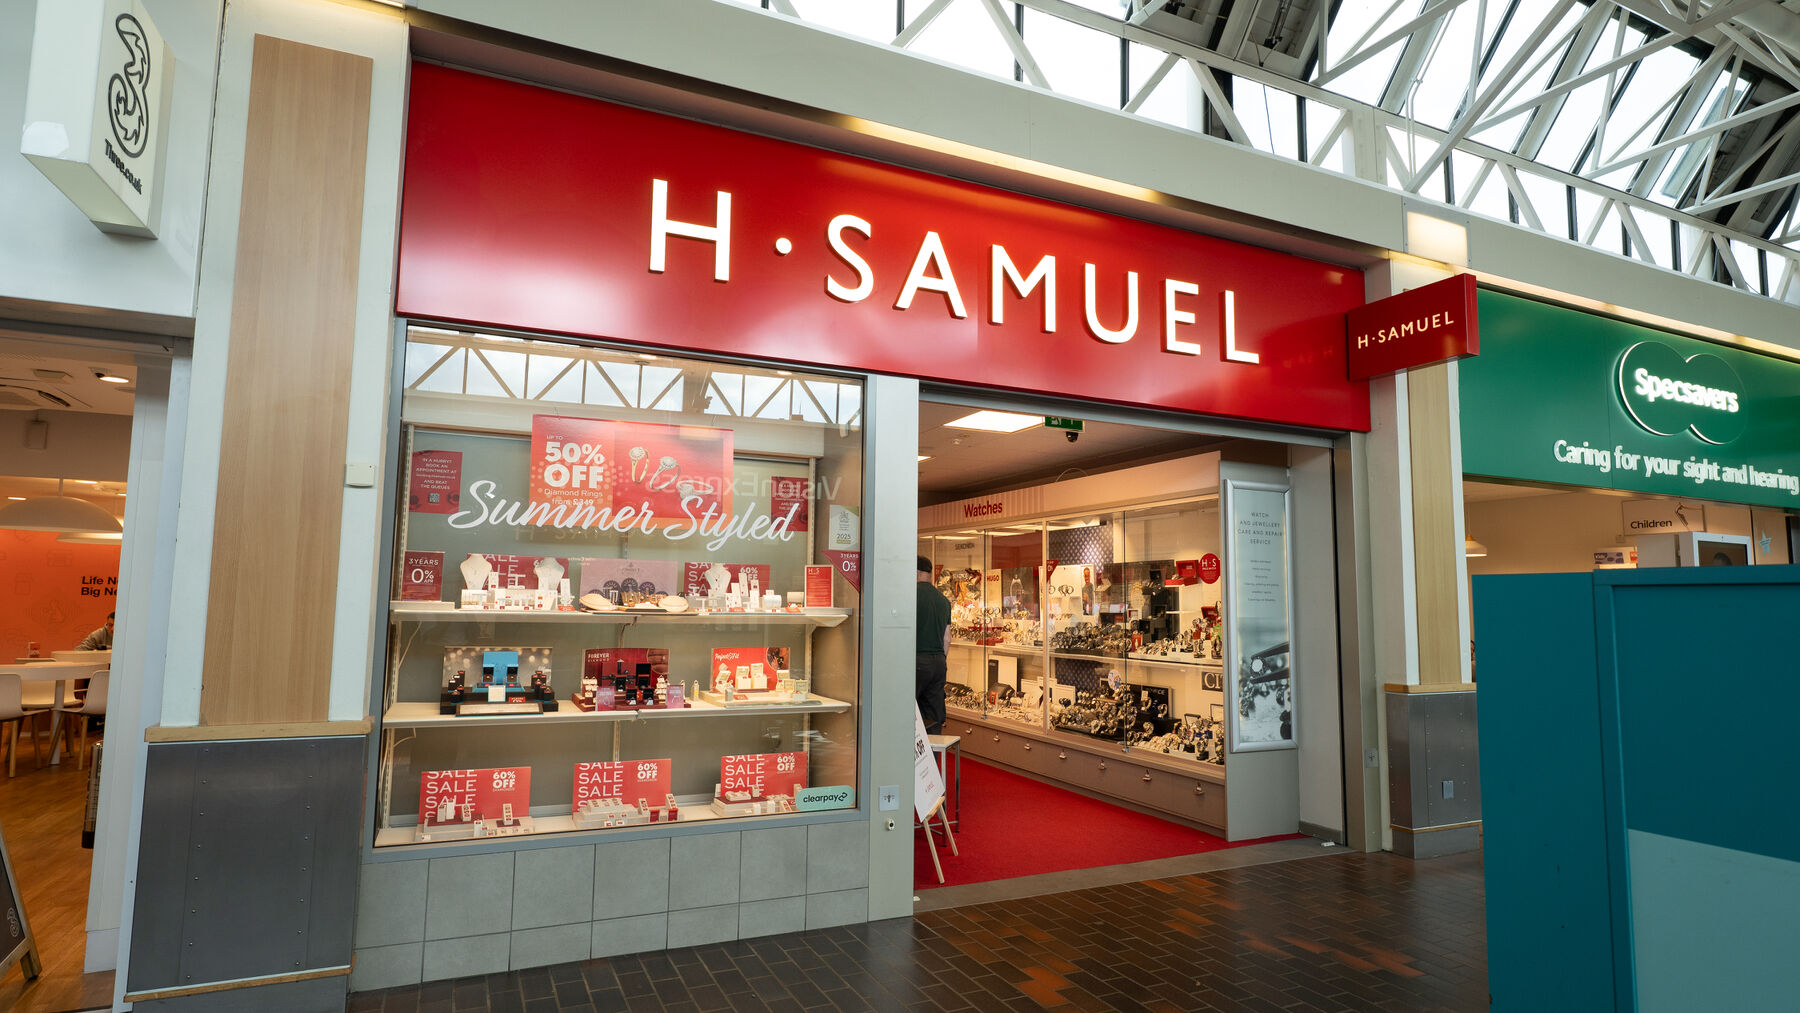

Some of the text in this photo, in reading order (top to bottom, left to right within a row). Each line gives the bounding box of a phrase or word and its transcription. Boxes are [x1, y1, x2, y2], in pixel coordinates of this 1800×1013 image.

[105, 138, 142, 195] Three.co.uk
[649, 178, 732, 283] H
[824, 213, 1260, 366] SAMUEL
[1634, 367, 1740, 413] Specsavers
[544, 441, 606, 465] 50%
[1553, 439, 1800, 496] Caring for your sight and hearing
[543, 463, 604, 488] OFF
[544, 488, 603, 498] Diamond Rings
[447, 479, 800, 552] Summer Styled
[964, 500, 1003, 518] Watches
[1630, 519, 1673, 530] Children
[82, 575, 104, 585] Life
[81, 586, 101, 597] Big
[637, 763, 658, 771] 60%
[725, 762, 765, 776] SALE
[777, 763, 795, 772] OFF
[493, 770, 516, 779] 60%
[578, 771, 623, 784] SALE
[637, 770, 658, 780] OFF
[426, 780, 477, 794] SALE
[492, 779, 516, 789] OFF
[725, 775, 765, 789] SALE
[578, 784, 623, 798] SALE
[803, 792, 838, 805] clearpay
